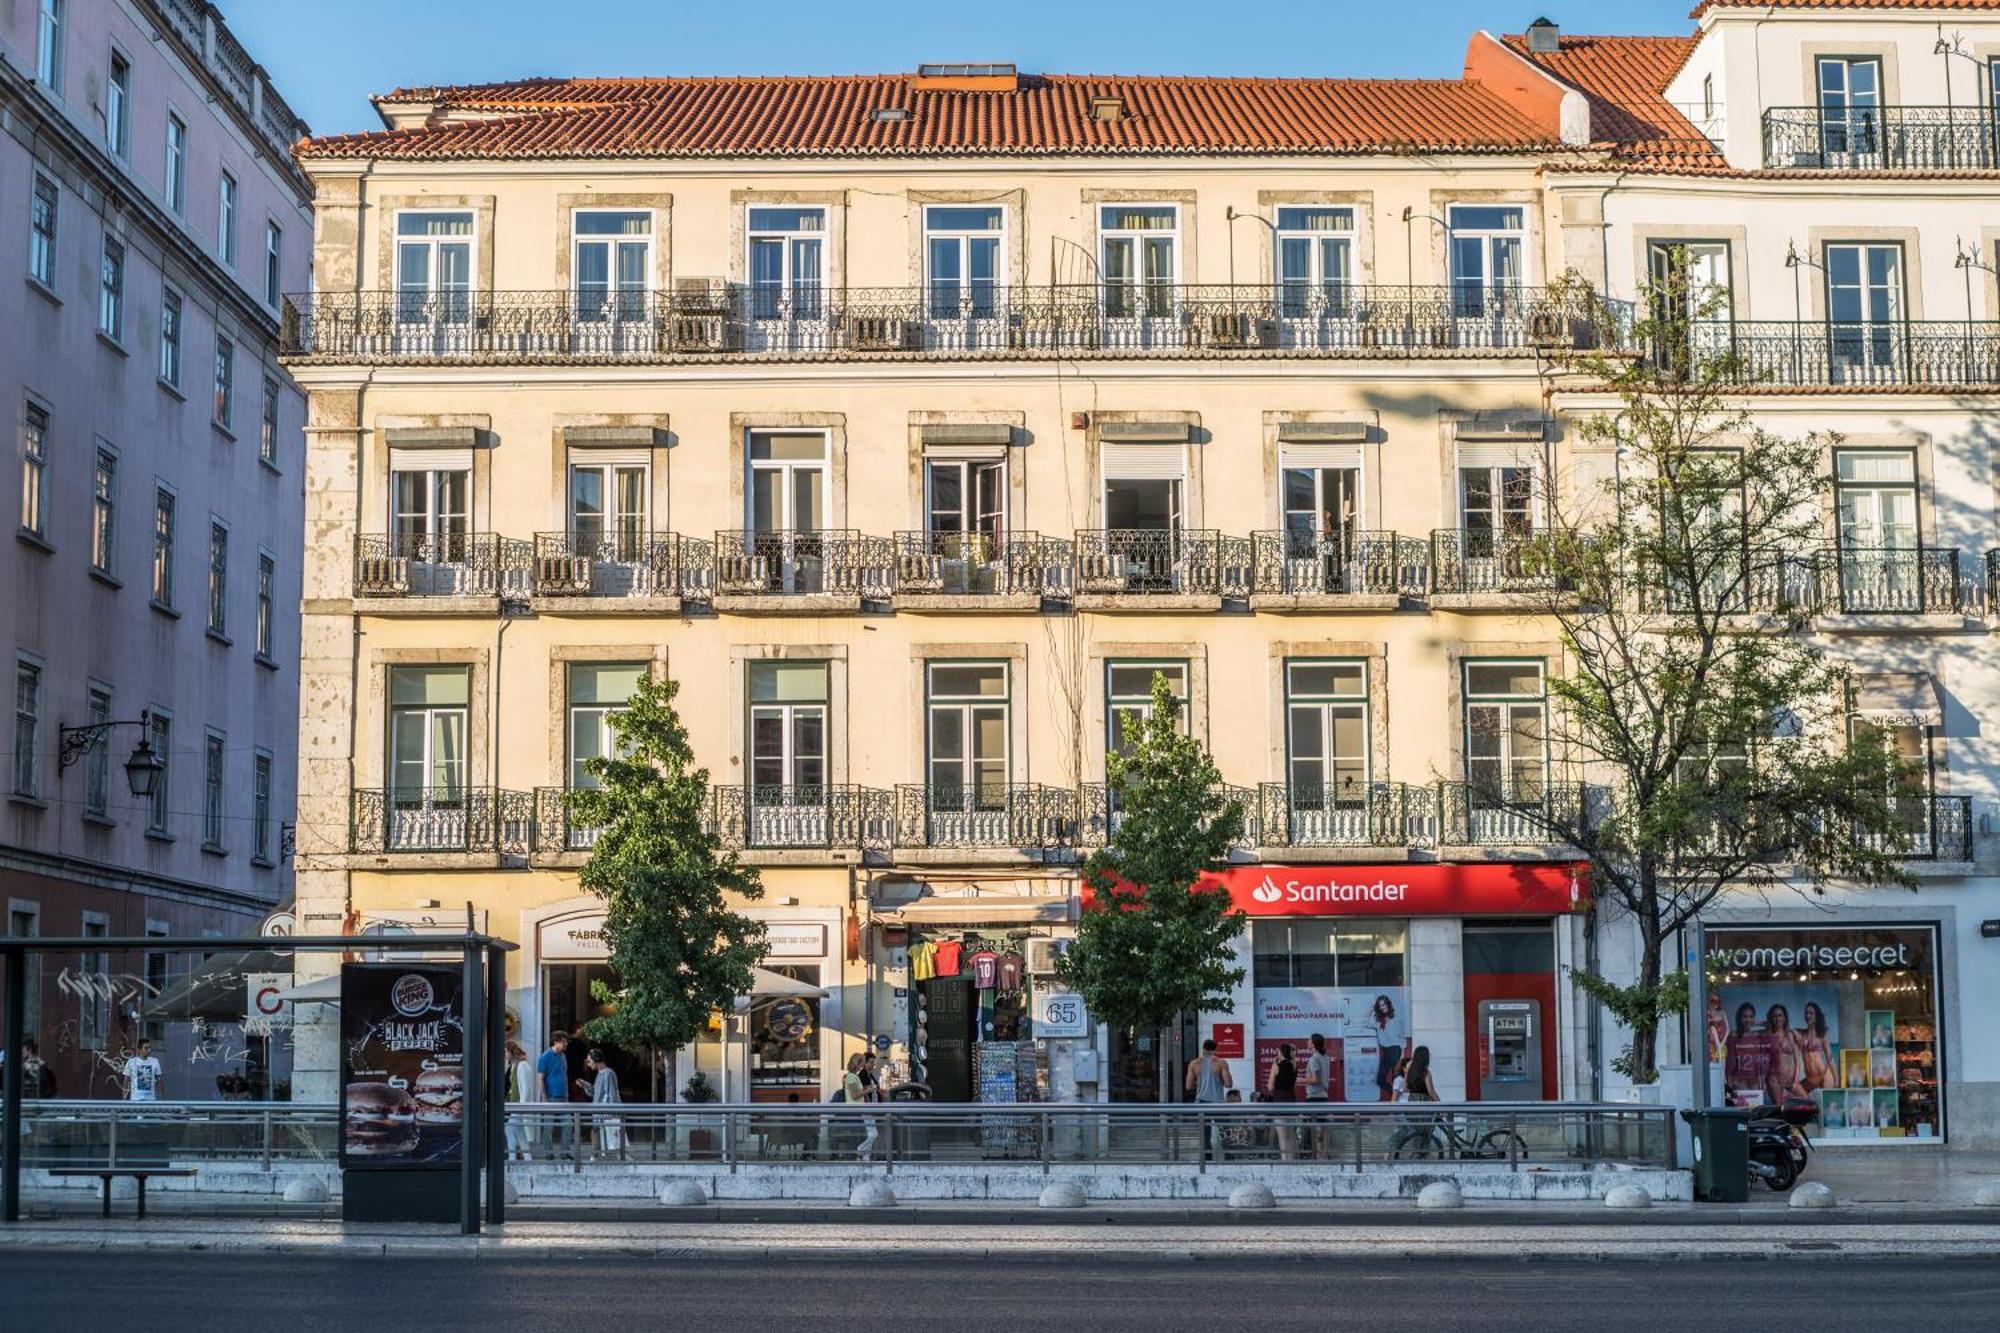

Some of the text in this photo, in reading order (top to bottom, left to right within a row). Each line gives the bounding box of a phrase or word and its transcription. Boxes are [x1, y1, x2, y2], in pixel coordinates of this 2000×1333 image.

[1872, 714, 1928, 725] w'secret
[1286, 880, 1408, 902] Santander
[1709, 944, 1907, 967] women'secret
[980, 963, 991, 978] 10
[398, 989, 429, 1004] KING
[1046, 1003, 1077, 1024] 65
[1496, 1019, 1516, 1027] ATM
[385, 1021, 440, 1041] BLACK JACK
[392, 1040, 434, 1051] PEPPER
